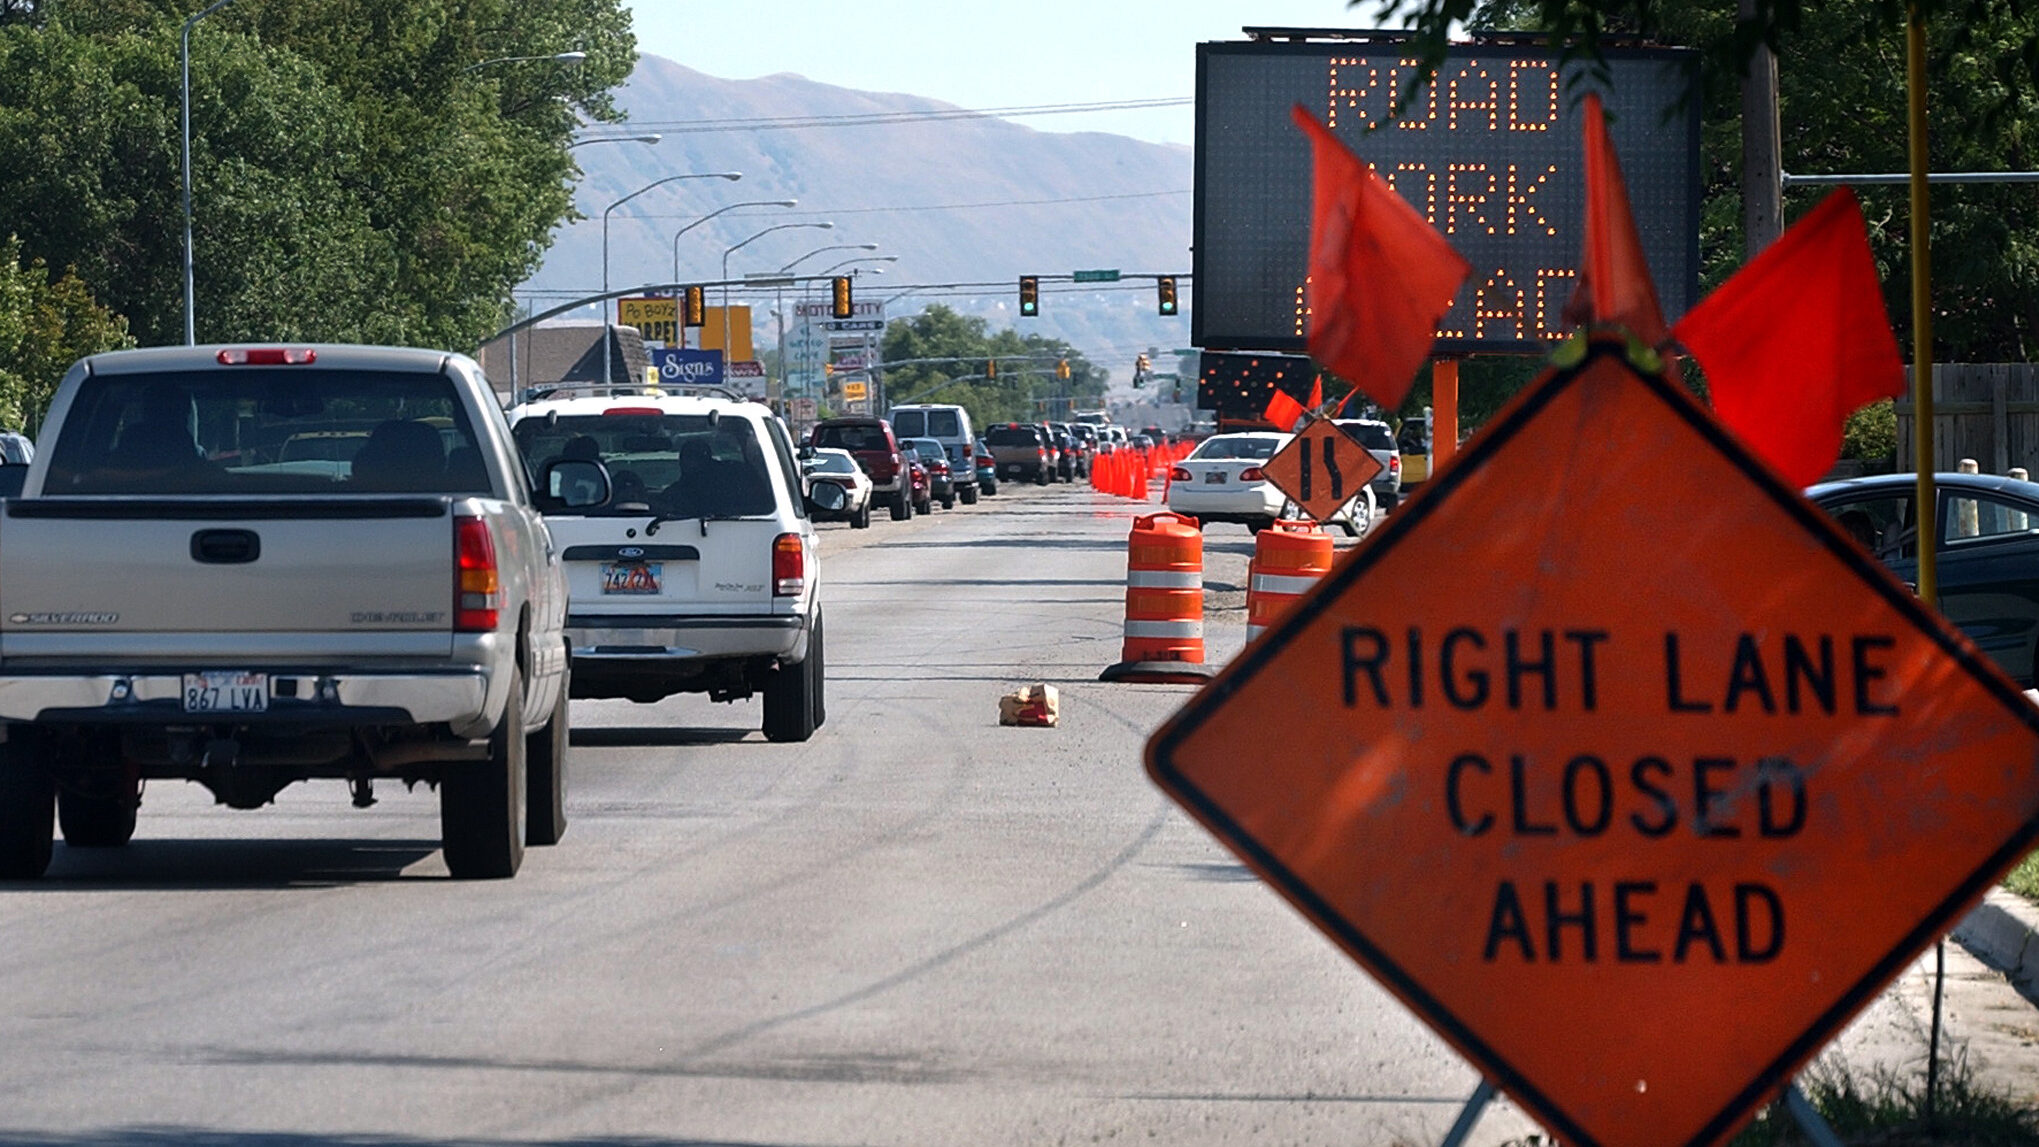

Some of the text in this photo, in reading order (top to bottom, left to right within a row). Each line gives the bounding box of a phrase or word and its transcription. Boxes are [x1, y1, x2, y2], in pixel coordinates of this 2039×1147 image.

[1328, 57, 1559, 130] ROAD
[1367, 161, 1557, 236] ORK
[625, 320, 678, 343] ARPET
[661, 353, 715, 383] Signs
[29, 612, 119, 624] SILVERADO
[351, 612, 444, 623] CHEVROLET
[1341, 625, 1900, 717] RIGHT LANE
[187, 687, 264, 711] 867 LVA
[1446, 754, 1808, 839] CLOSED
[1484, 880, 1786, 965] AHEAD
